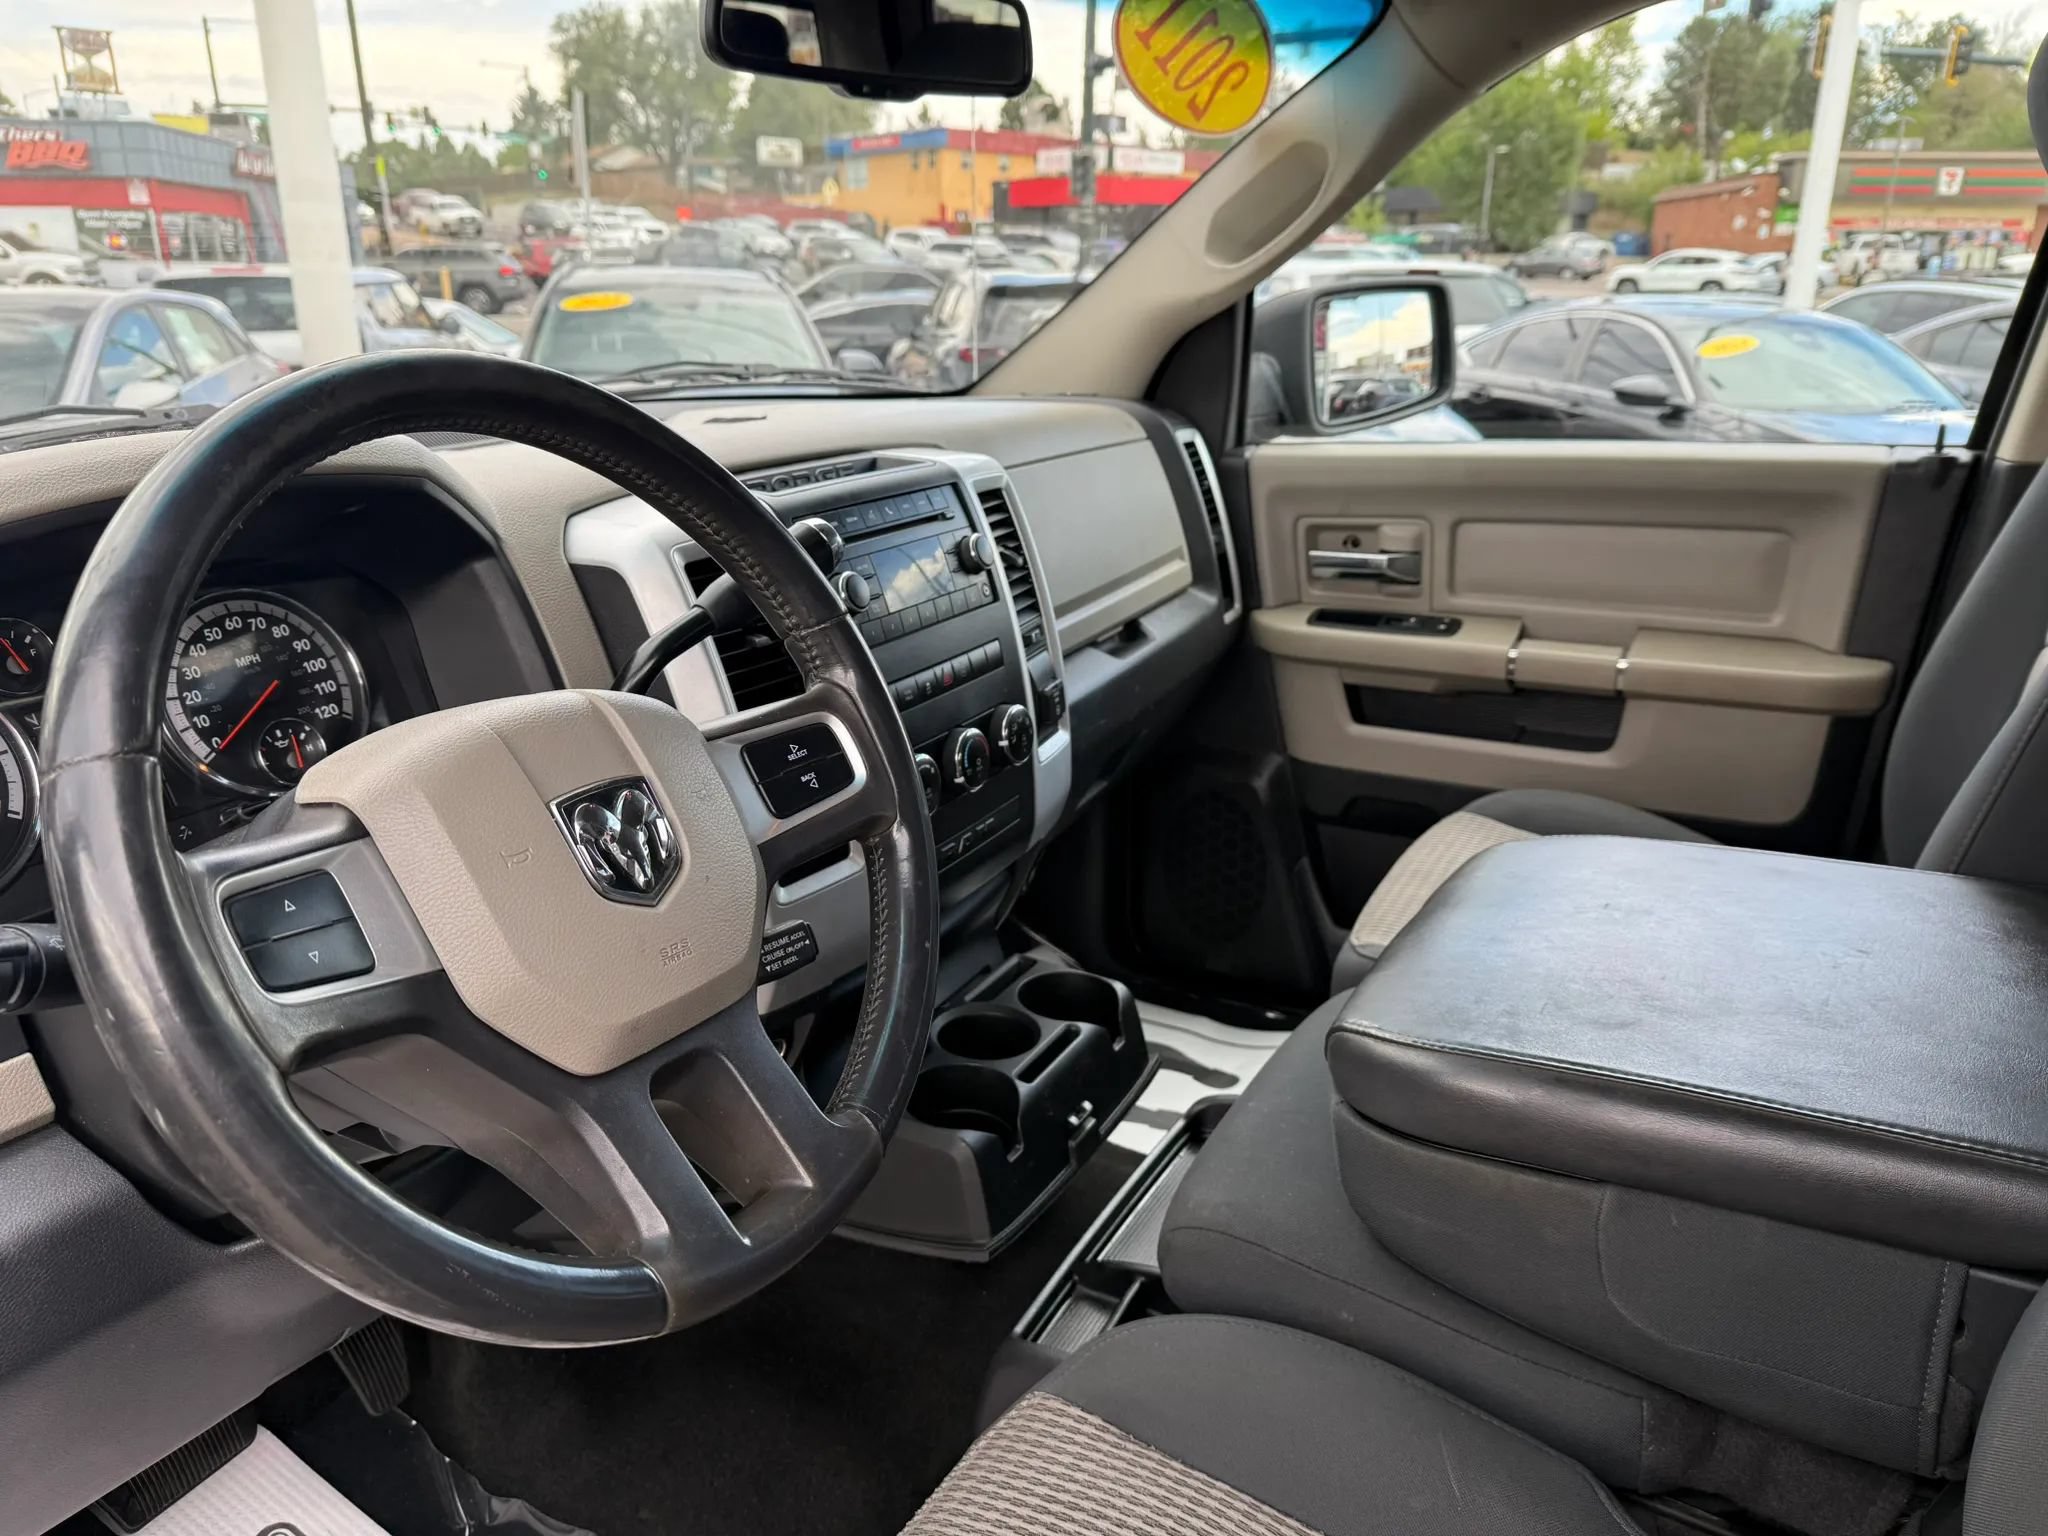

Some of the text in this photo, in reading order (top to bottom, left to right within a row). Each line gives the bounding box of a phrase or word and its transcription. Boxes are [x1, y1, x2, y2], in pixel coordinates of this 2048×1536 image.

[6, 140, 88, 171] BBQ
[225, 616, 242, 630] 60
[248, 617, 267, 631] 70
[204, 627, 222, 642] 50
[272, 624, 290, 639] 80
[30, 648, 37, 657] F
[189, 643, 207, 658] 40
[292, 638, 311, 653] 90
[234, 653, 261, 668] MPH
[303, 657, 328, 673] 100
[183, 666, 201, 681] 30
[314, 680, 337, 696] 110
[183, 690, 202, 705] 20
[314, 703, 339, 720] 120
[193, 714, 211, 729] 10
[787, 749, 808, 761] SELECT
[800, 772, 817, 782] BACK
[763, 931, 806, 952] RESUME ACCEL
[762, 949, 785, 963] CRUISE
[771, 955, 799, 971] SET DECEL
